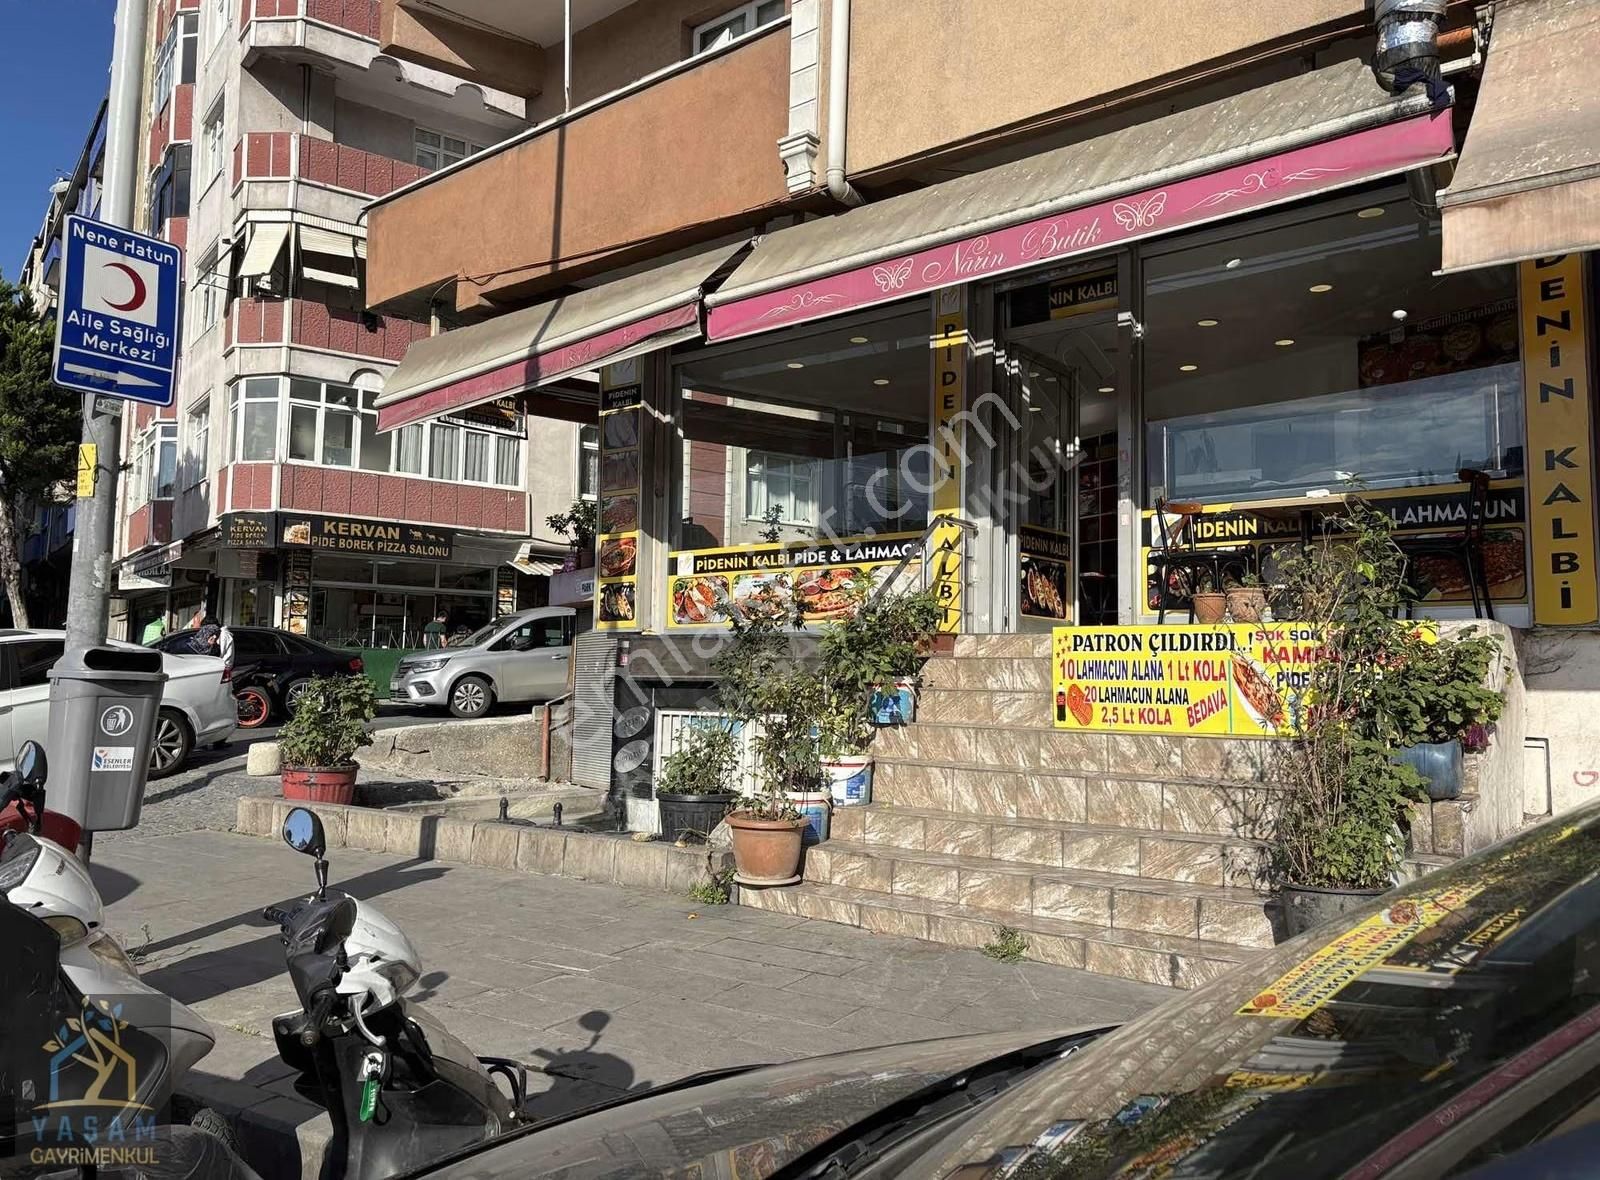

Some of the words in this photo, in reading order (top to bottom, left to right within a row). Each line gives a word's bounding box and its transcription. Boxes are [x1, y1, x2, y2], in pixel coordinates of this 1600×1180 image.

[73, 222, 118, 249] Nene
[123, 239, 174, 265] Hatun
[1020, 217, 1102, 260] Butik
[66, 310, 104, 330] Aile
[110, 320, 170, 349] Sağlığı
[83, 332, 156, 362] Merkezi
[323, 521, 400, 540] KERVAN
[1542, 446, 1581, 609] KALBİ
[311, 534, 336, 548] PİDE
[377, 540, 407, 553] PİZZA
[409, 544, 449, 557] SALONU
[696, 555, 748, 571] PİDENİN
[752, 553, 790, 567] KALBİ
[795, 549, 826, 564] PİDE
[830, 549, 841, 561] &
[1073, 633, 1143, 652] PATRON
[1131, 659, 1164, 681] ALANA
[1167, 660, 1173, 681] 1
[1178, 660, 1190, 681] Lt
[1193, 660, 1227, 682] KOLA
[1084, 686, 1098, 704] 20
[1098, 686, 1153, 704] LAHMACUN
[1155, 687, 1190, 706] ALANA
[1186, 687, 1229, 728] BEDAVA
[1101, 706, 1119, 727] 2,5
[1122, 707, 1135, 725] Lt
[1138, 708, 1172, 726] KOLA
